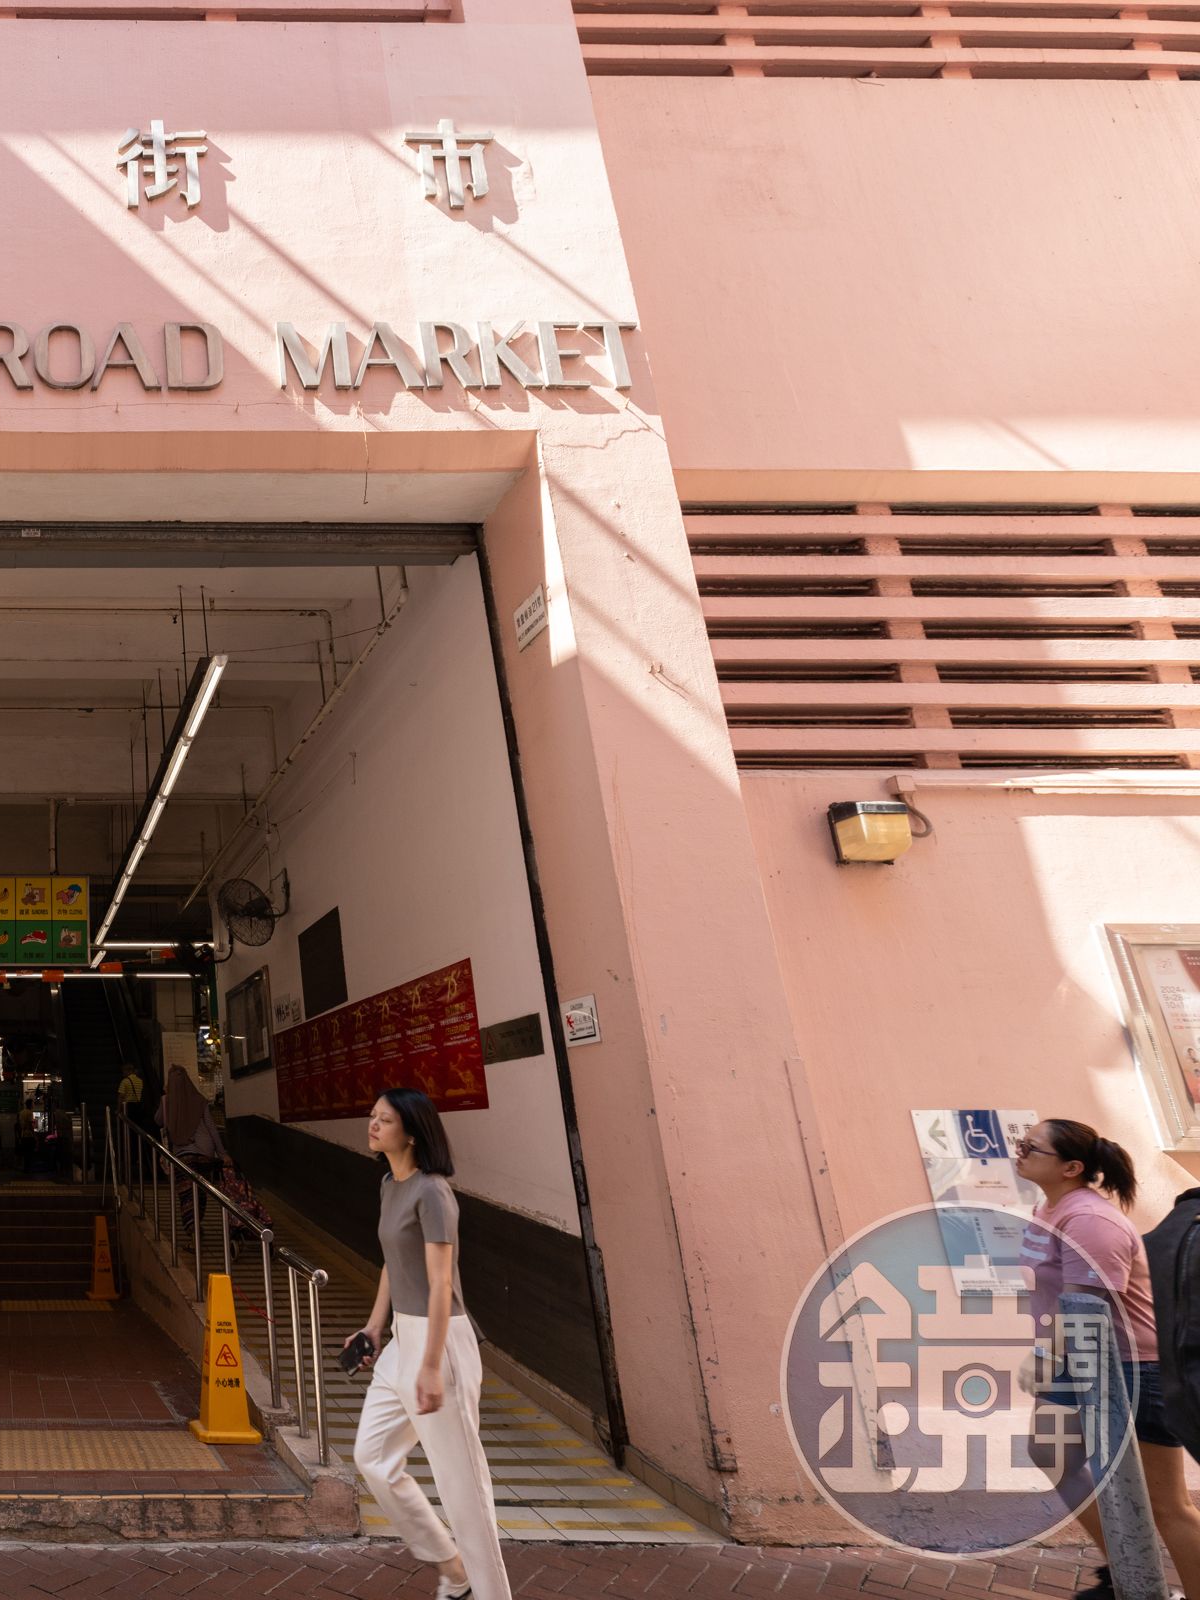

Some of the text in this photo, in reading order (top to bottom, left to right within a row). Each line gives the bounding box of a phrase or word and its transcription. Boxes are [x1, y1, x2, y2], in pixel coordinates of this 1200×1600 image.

[275, 320, 638, 391] MARKET
[215, 1377, 240, 1388] 小心地滑
